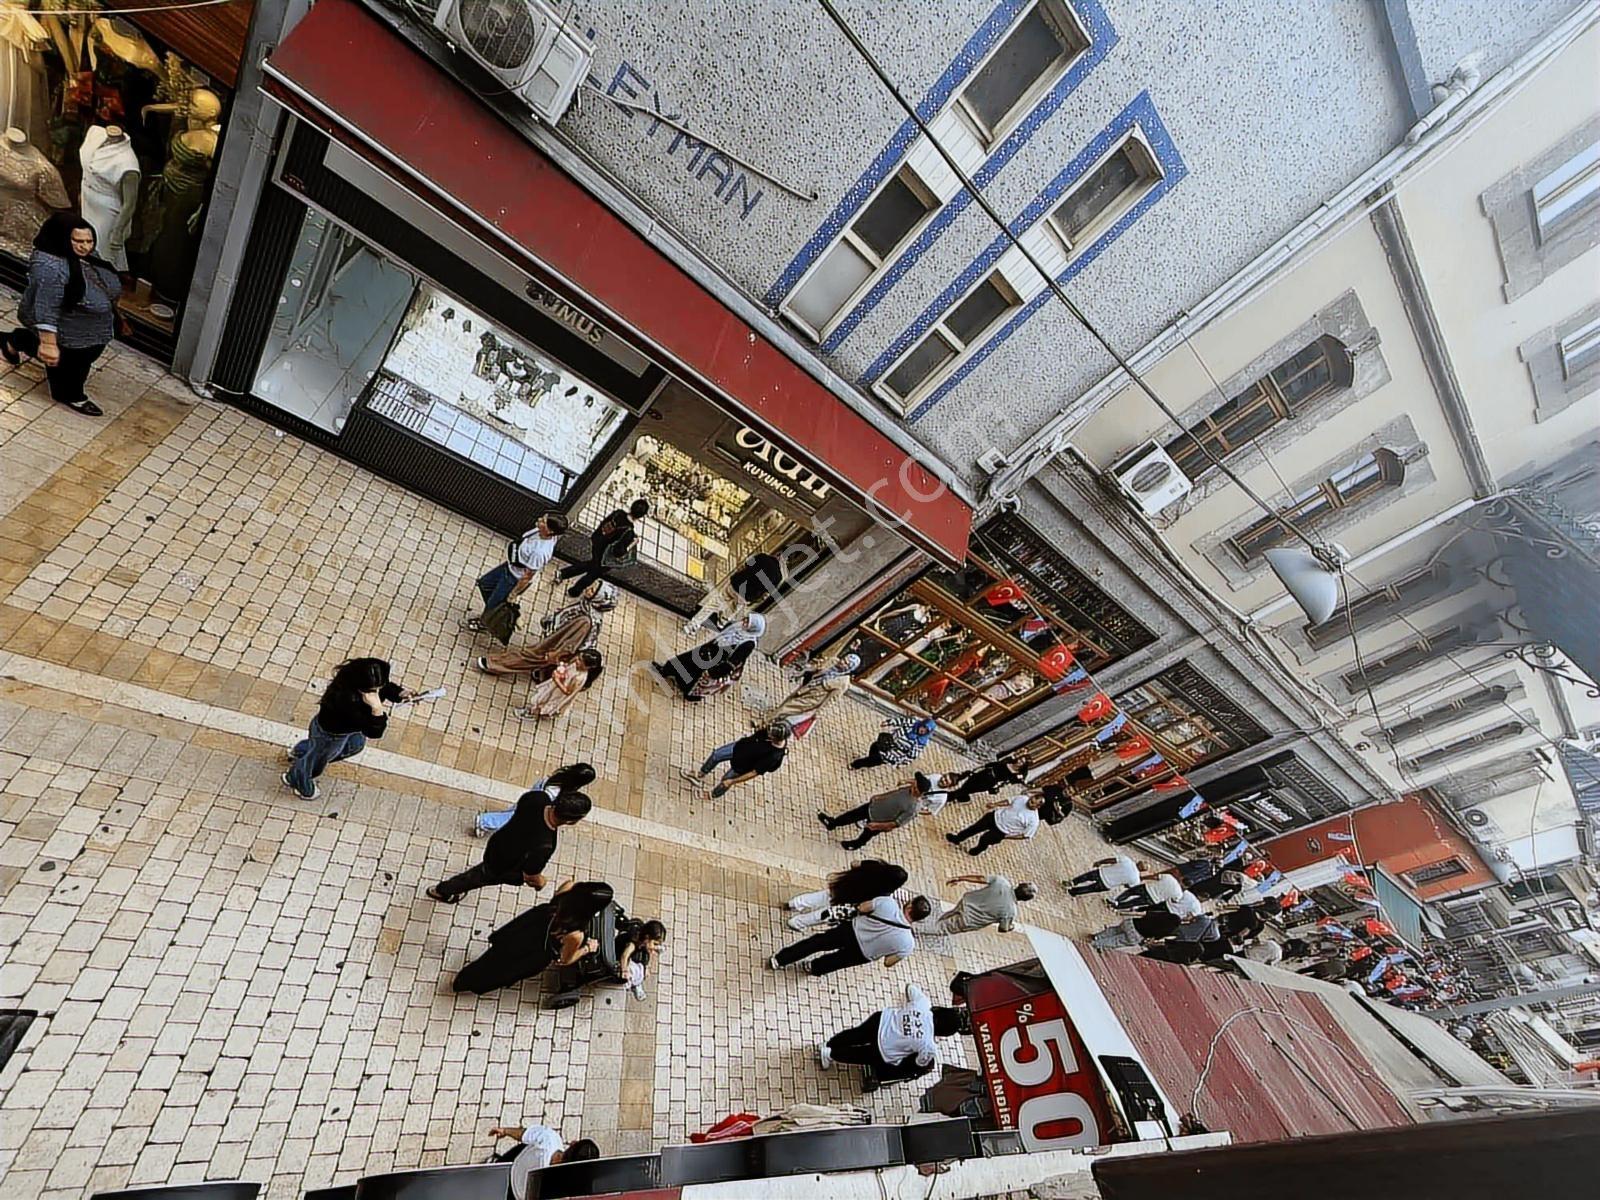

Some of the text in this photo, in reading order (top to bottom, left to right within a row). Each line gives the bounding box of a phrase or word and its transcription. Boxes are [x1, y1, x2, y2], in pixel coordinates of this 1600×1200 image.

[587, 60, 764, 221] EYMAN
[743, 461, 797, 498] KUYUMCU
[979, 1023, 1015, 1131] VARAN İNDİRİ
